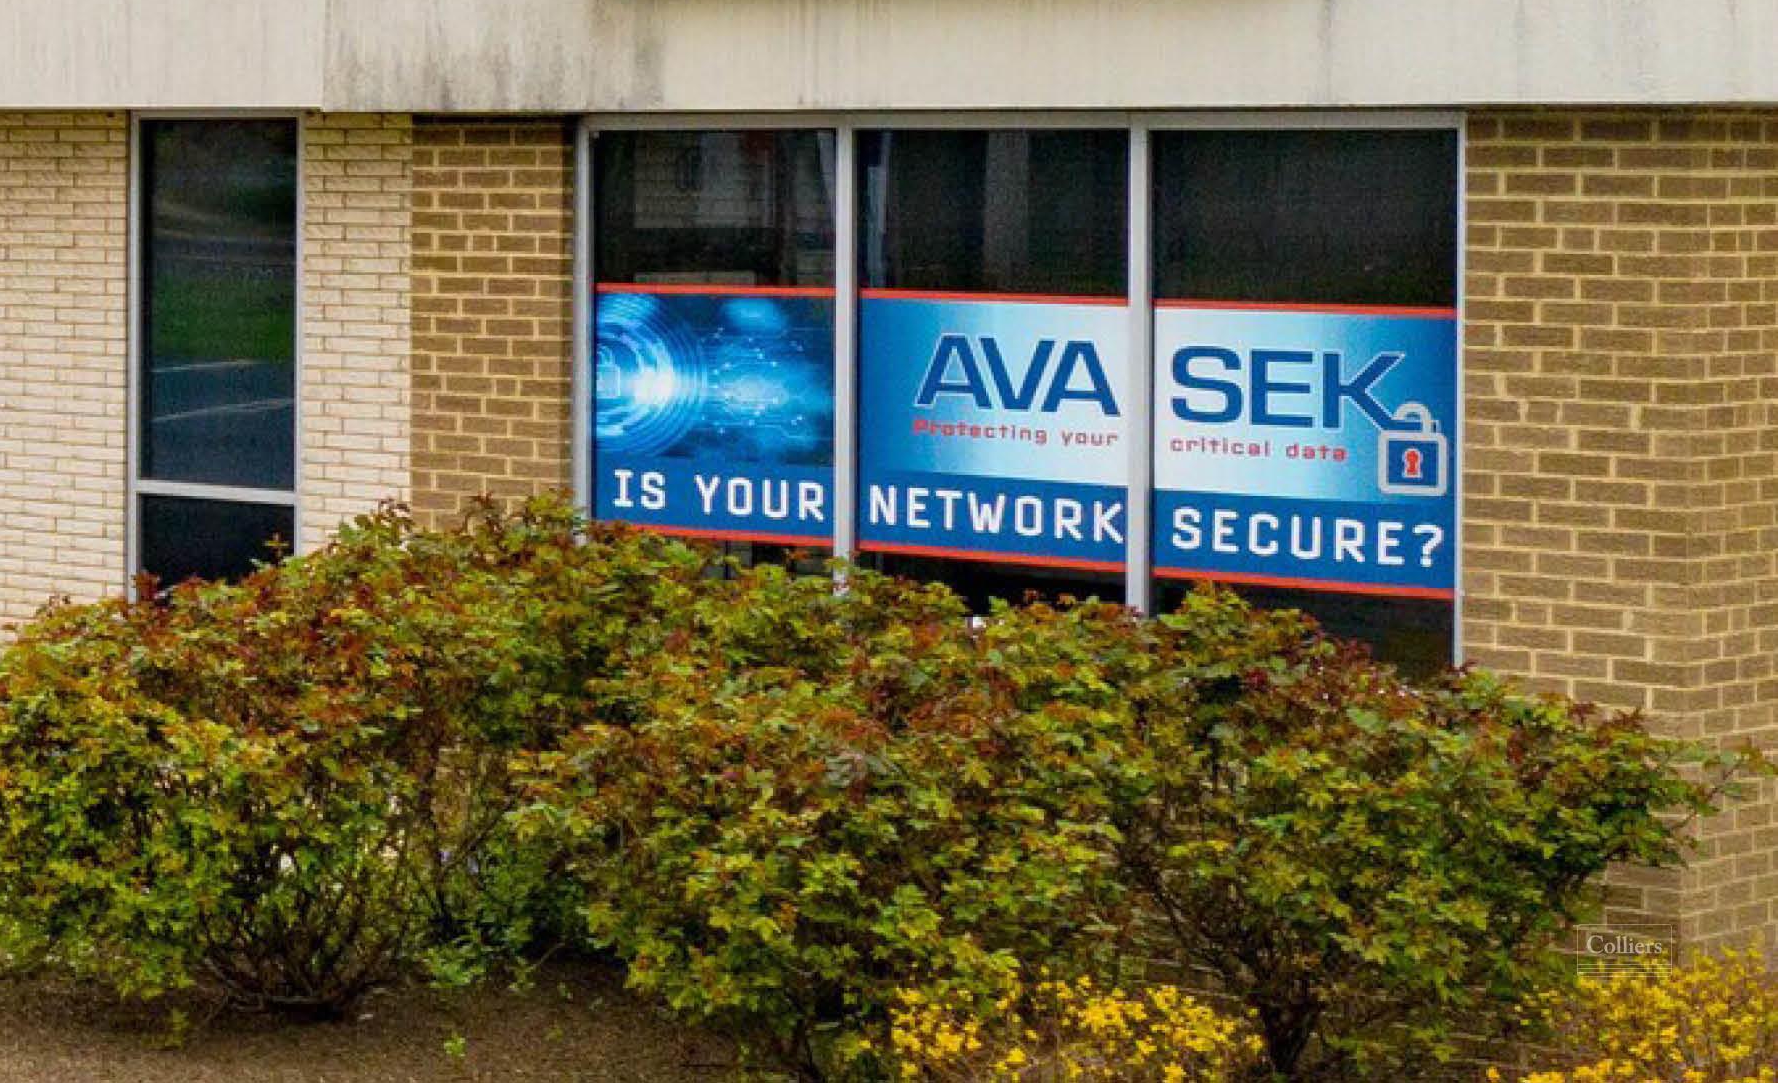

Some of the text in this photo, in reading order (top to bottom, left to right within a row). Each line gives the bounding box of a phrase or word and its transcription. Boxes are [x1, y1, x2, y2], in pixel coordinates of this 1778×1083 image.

[914, 332, 1407, 432] AVA SEK
[912, 419, 1348, 463] Protecting your critical data
[612, 468, 1444, 571] IS YOUR NETWORK SECURE?
